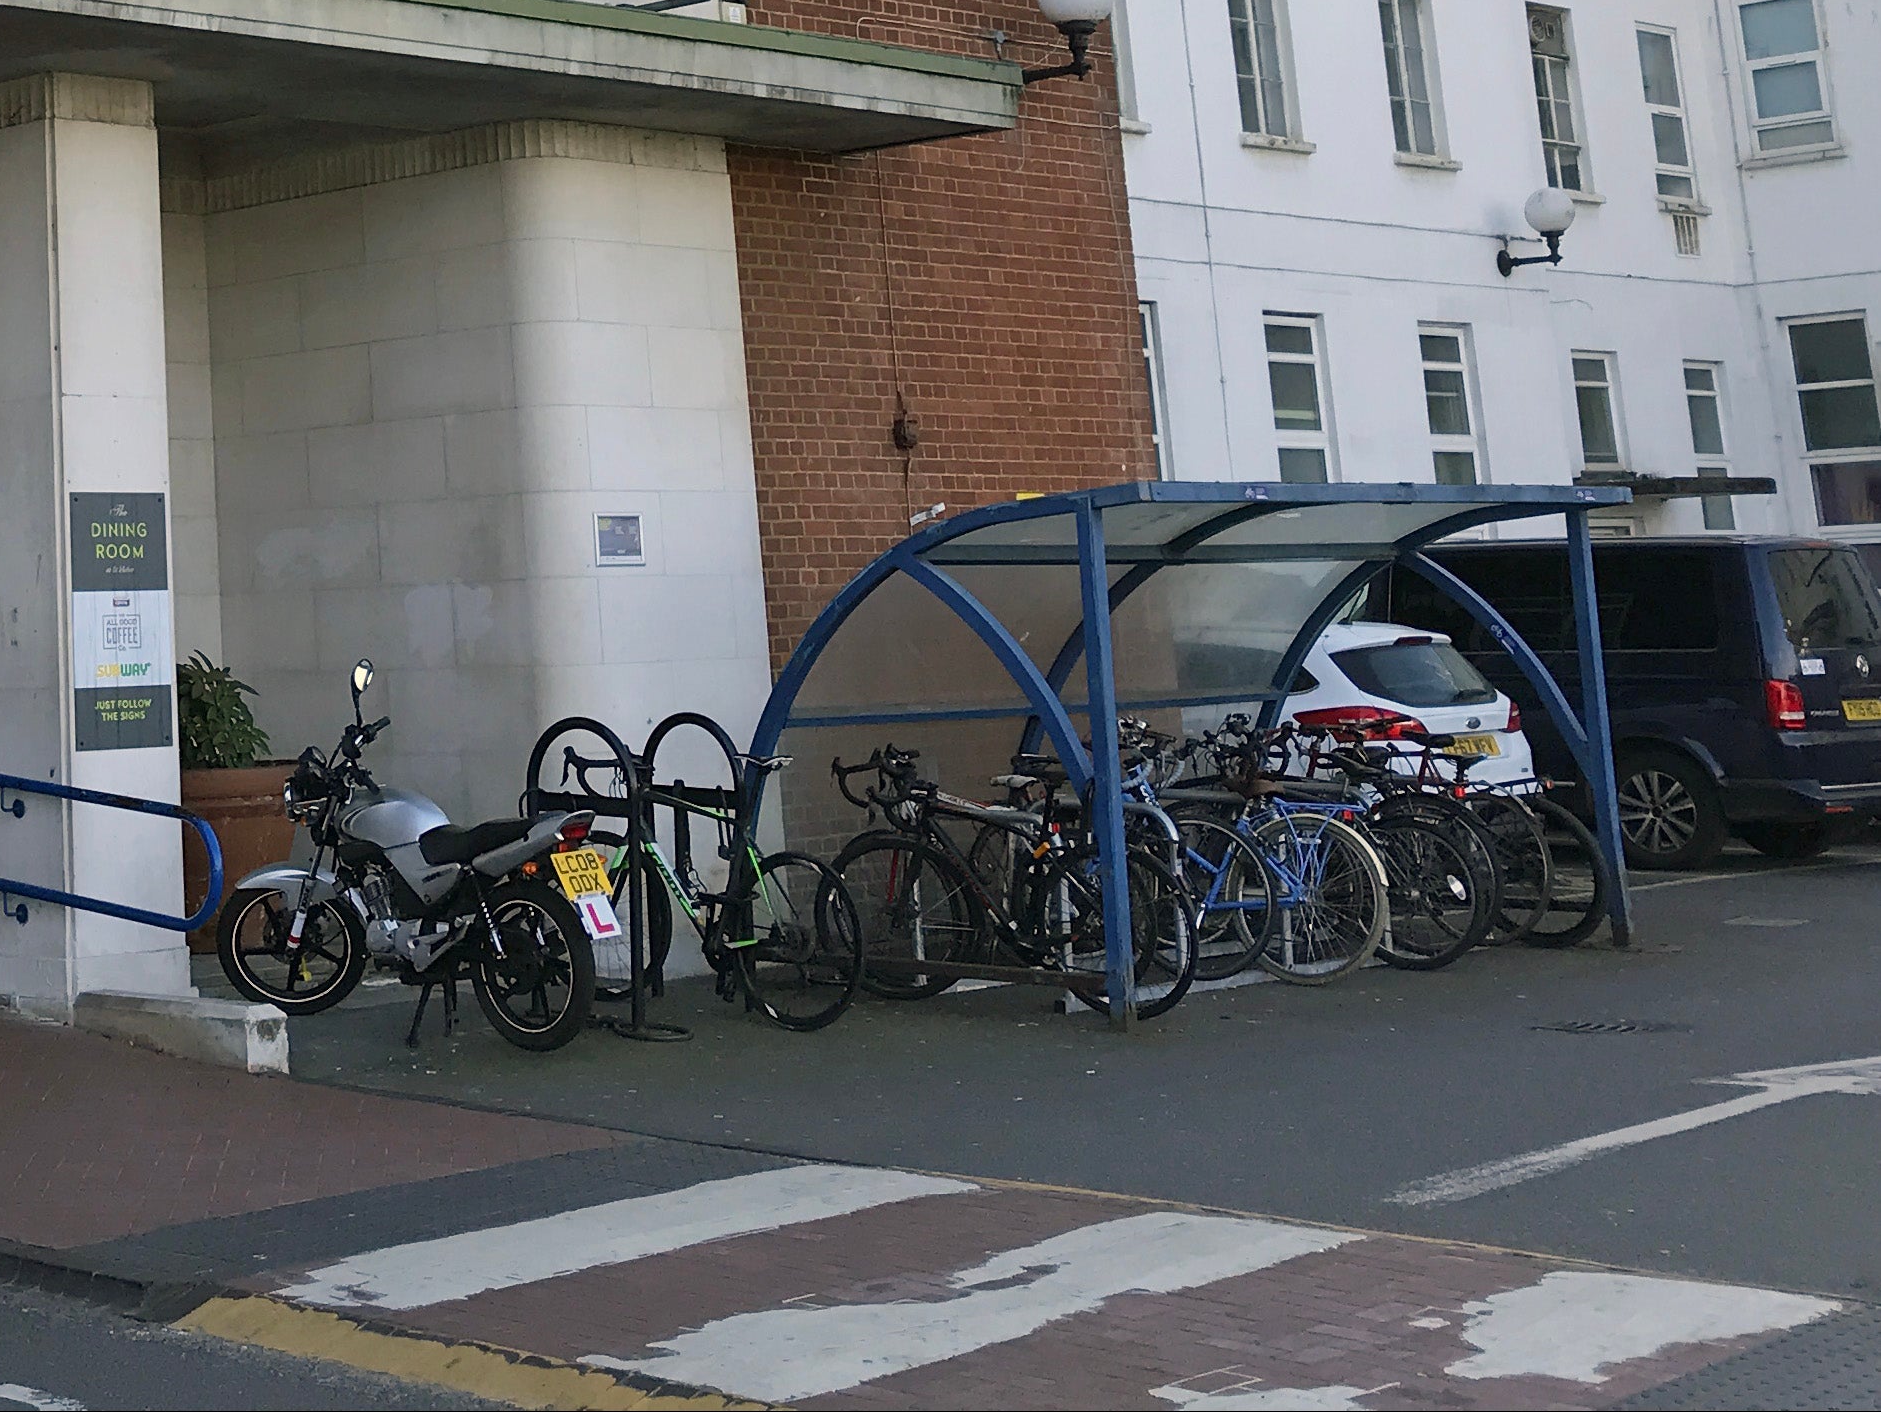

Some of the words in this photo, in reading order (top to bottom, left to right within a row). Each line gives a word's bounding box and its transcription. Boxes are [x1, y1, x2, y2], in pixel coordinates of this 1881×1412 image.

[91, 522, 148, 538] DINING
[95, 543, 145, 560] ROOM
[106, 627, 138, 645] COFFEE
[94, 700, 116, 710] JUST
[117, 698, 152, 709] FOLLOW
[101, 711, 119, 722] THE
[120, 710, 146, 721] SIGNS
[585, 903, 615, 933] L
